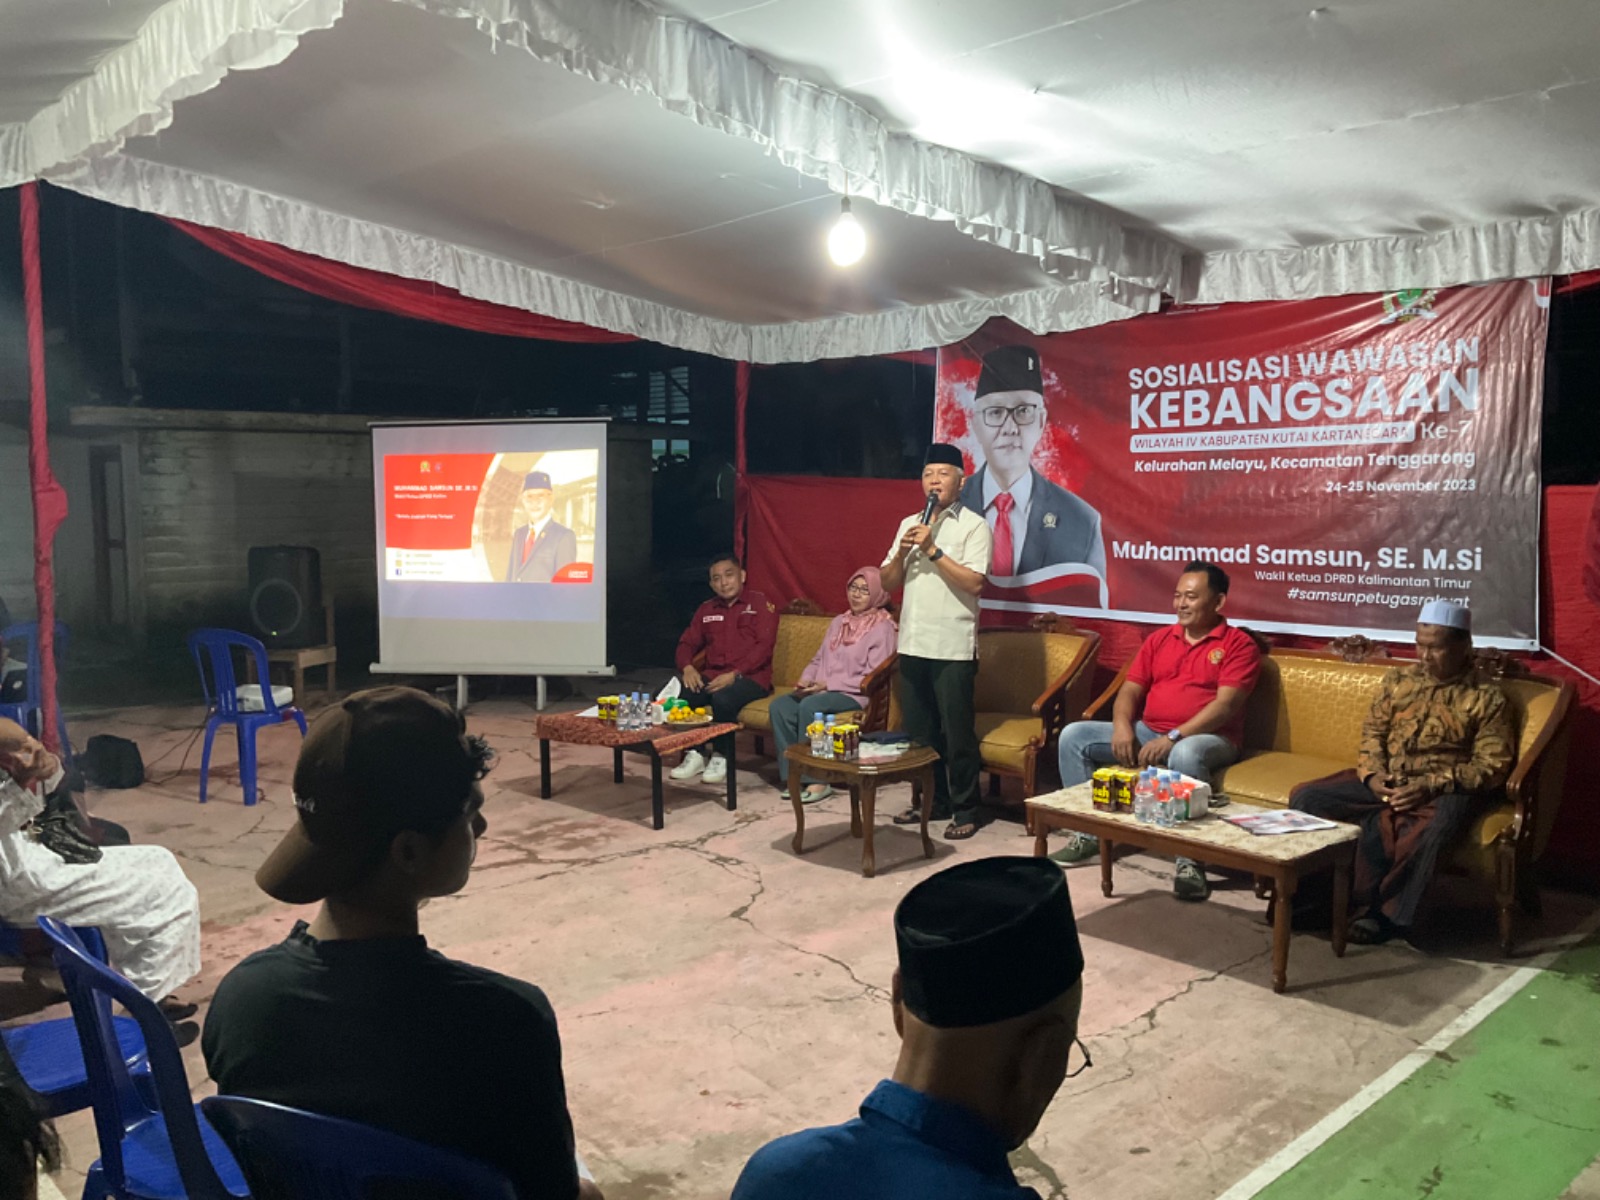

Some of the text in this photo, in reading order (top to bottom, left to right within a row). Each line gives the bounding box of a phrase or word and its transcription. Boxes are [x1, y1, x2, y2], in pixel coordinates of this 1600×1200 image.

[1129, 336, 1479, 390] SOSIALISASI WAWASAN
[1130, 368, 1479, 430] KEBANGSAAN
[1134, 438, 1184, 449] WILAYAH
[1186, 437, 1198, 447] IV
[1200, 434, 1269, 447] KABUPATEN
[1272, 431, 1308, 444] KUTAI
[1420, 420, 1473, 439] Ke-7
[1134, 451, 1476, 474] Kelurahan Melayu, Kecamatan Tenggarong
[1326, 479, 1477, 493] 24-25 November 2023
[1112, 541, 1483, 571] Muhammad Samsun, SE. M.Si
[1254, 571, 1472, 589] Wakil Ketua DPRD Kalimantan Timur
